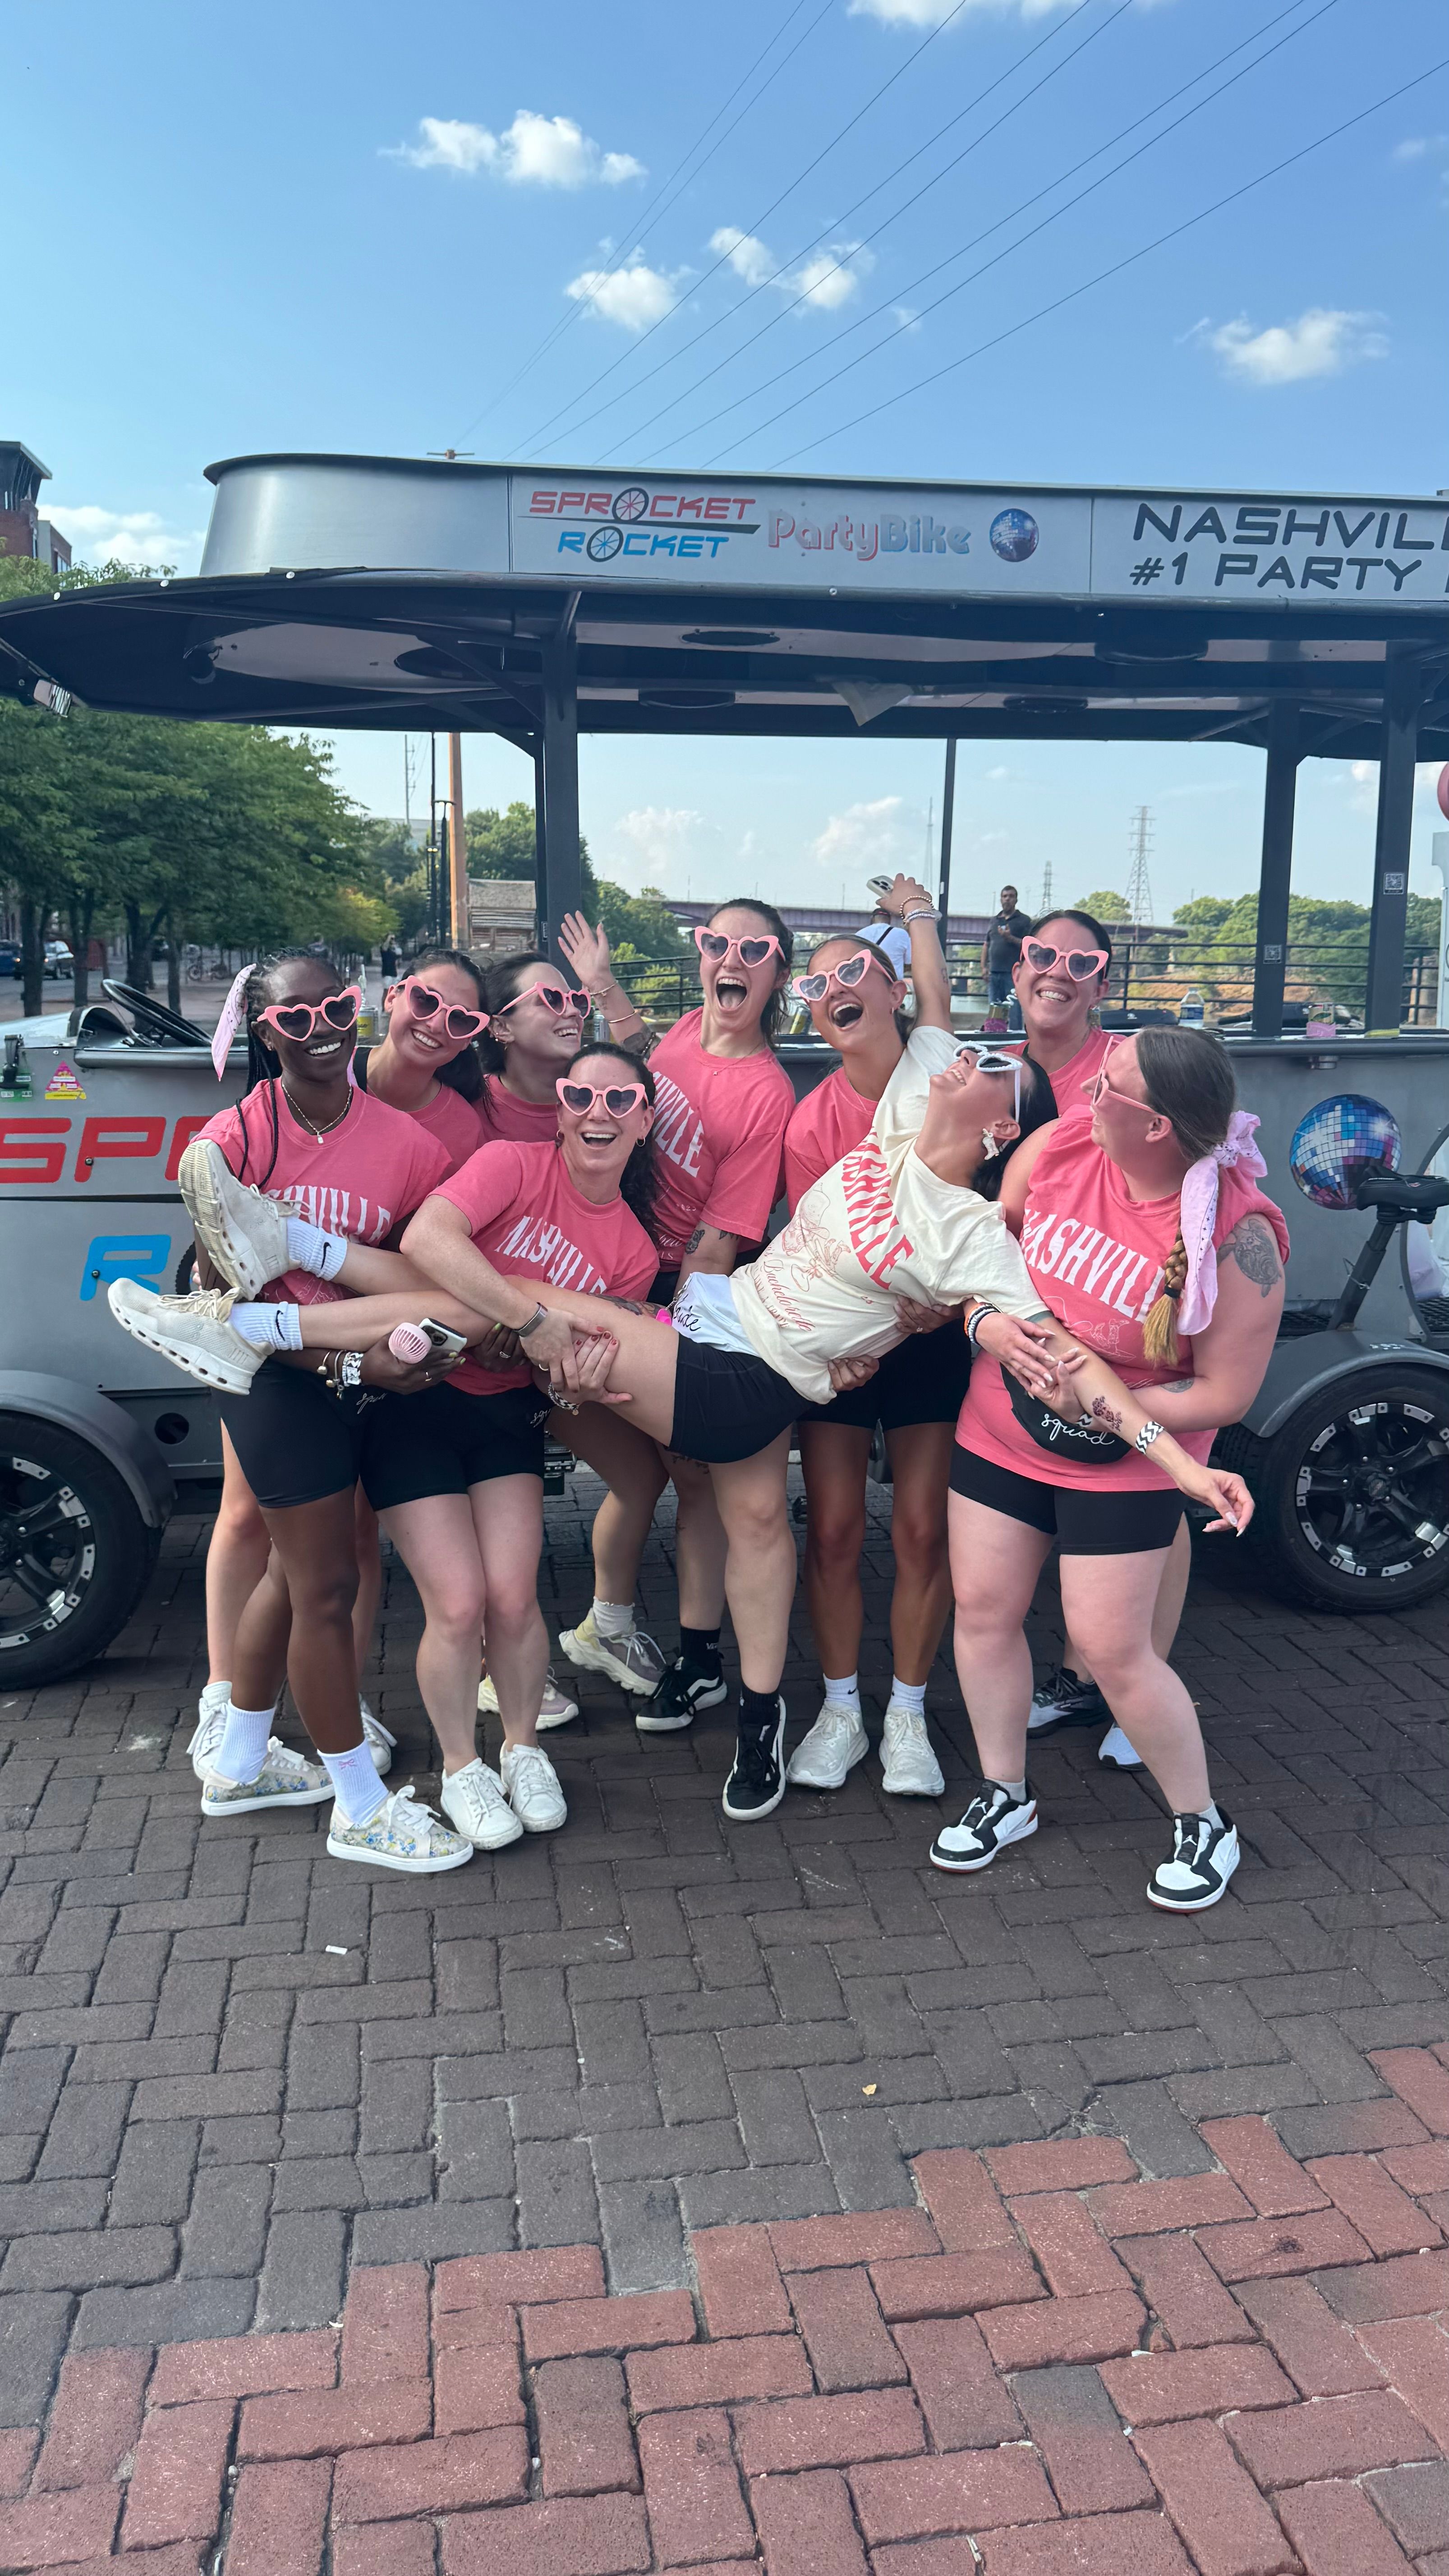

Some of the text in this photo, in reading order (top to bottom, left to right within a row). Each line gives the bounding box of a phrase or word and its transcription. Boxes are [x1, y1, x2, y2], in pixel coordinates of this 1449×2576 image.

[529, 488, 756, 523] SPROCKET
[558, 526, 729, 562] ROCKET
[768, 511, 971, 561] PartyBike
[1133, 503, 1449, 550] NASHVIL
[1129, 552, 1188, 586] #1
[1214, 553, 1422, 592] PARTY
[1041, 1413, 1115, 1445] squad
